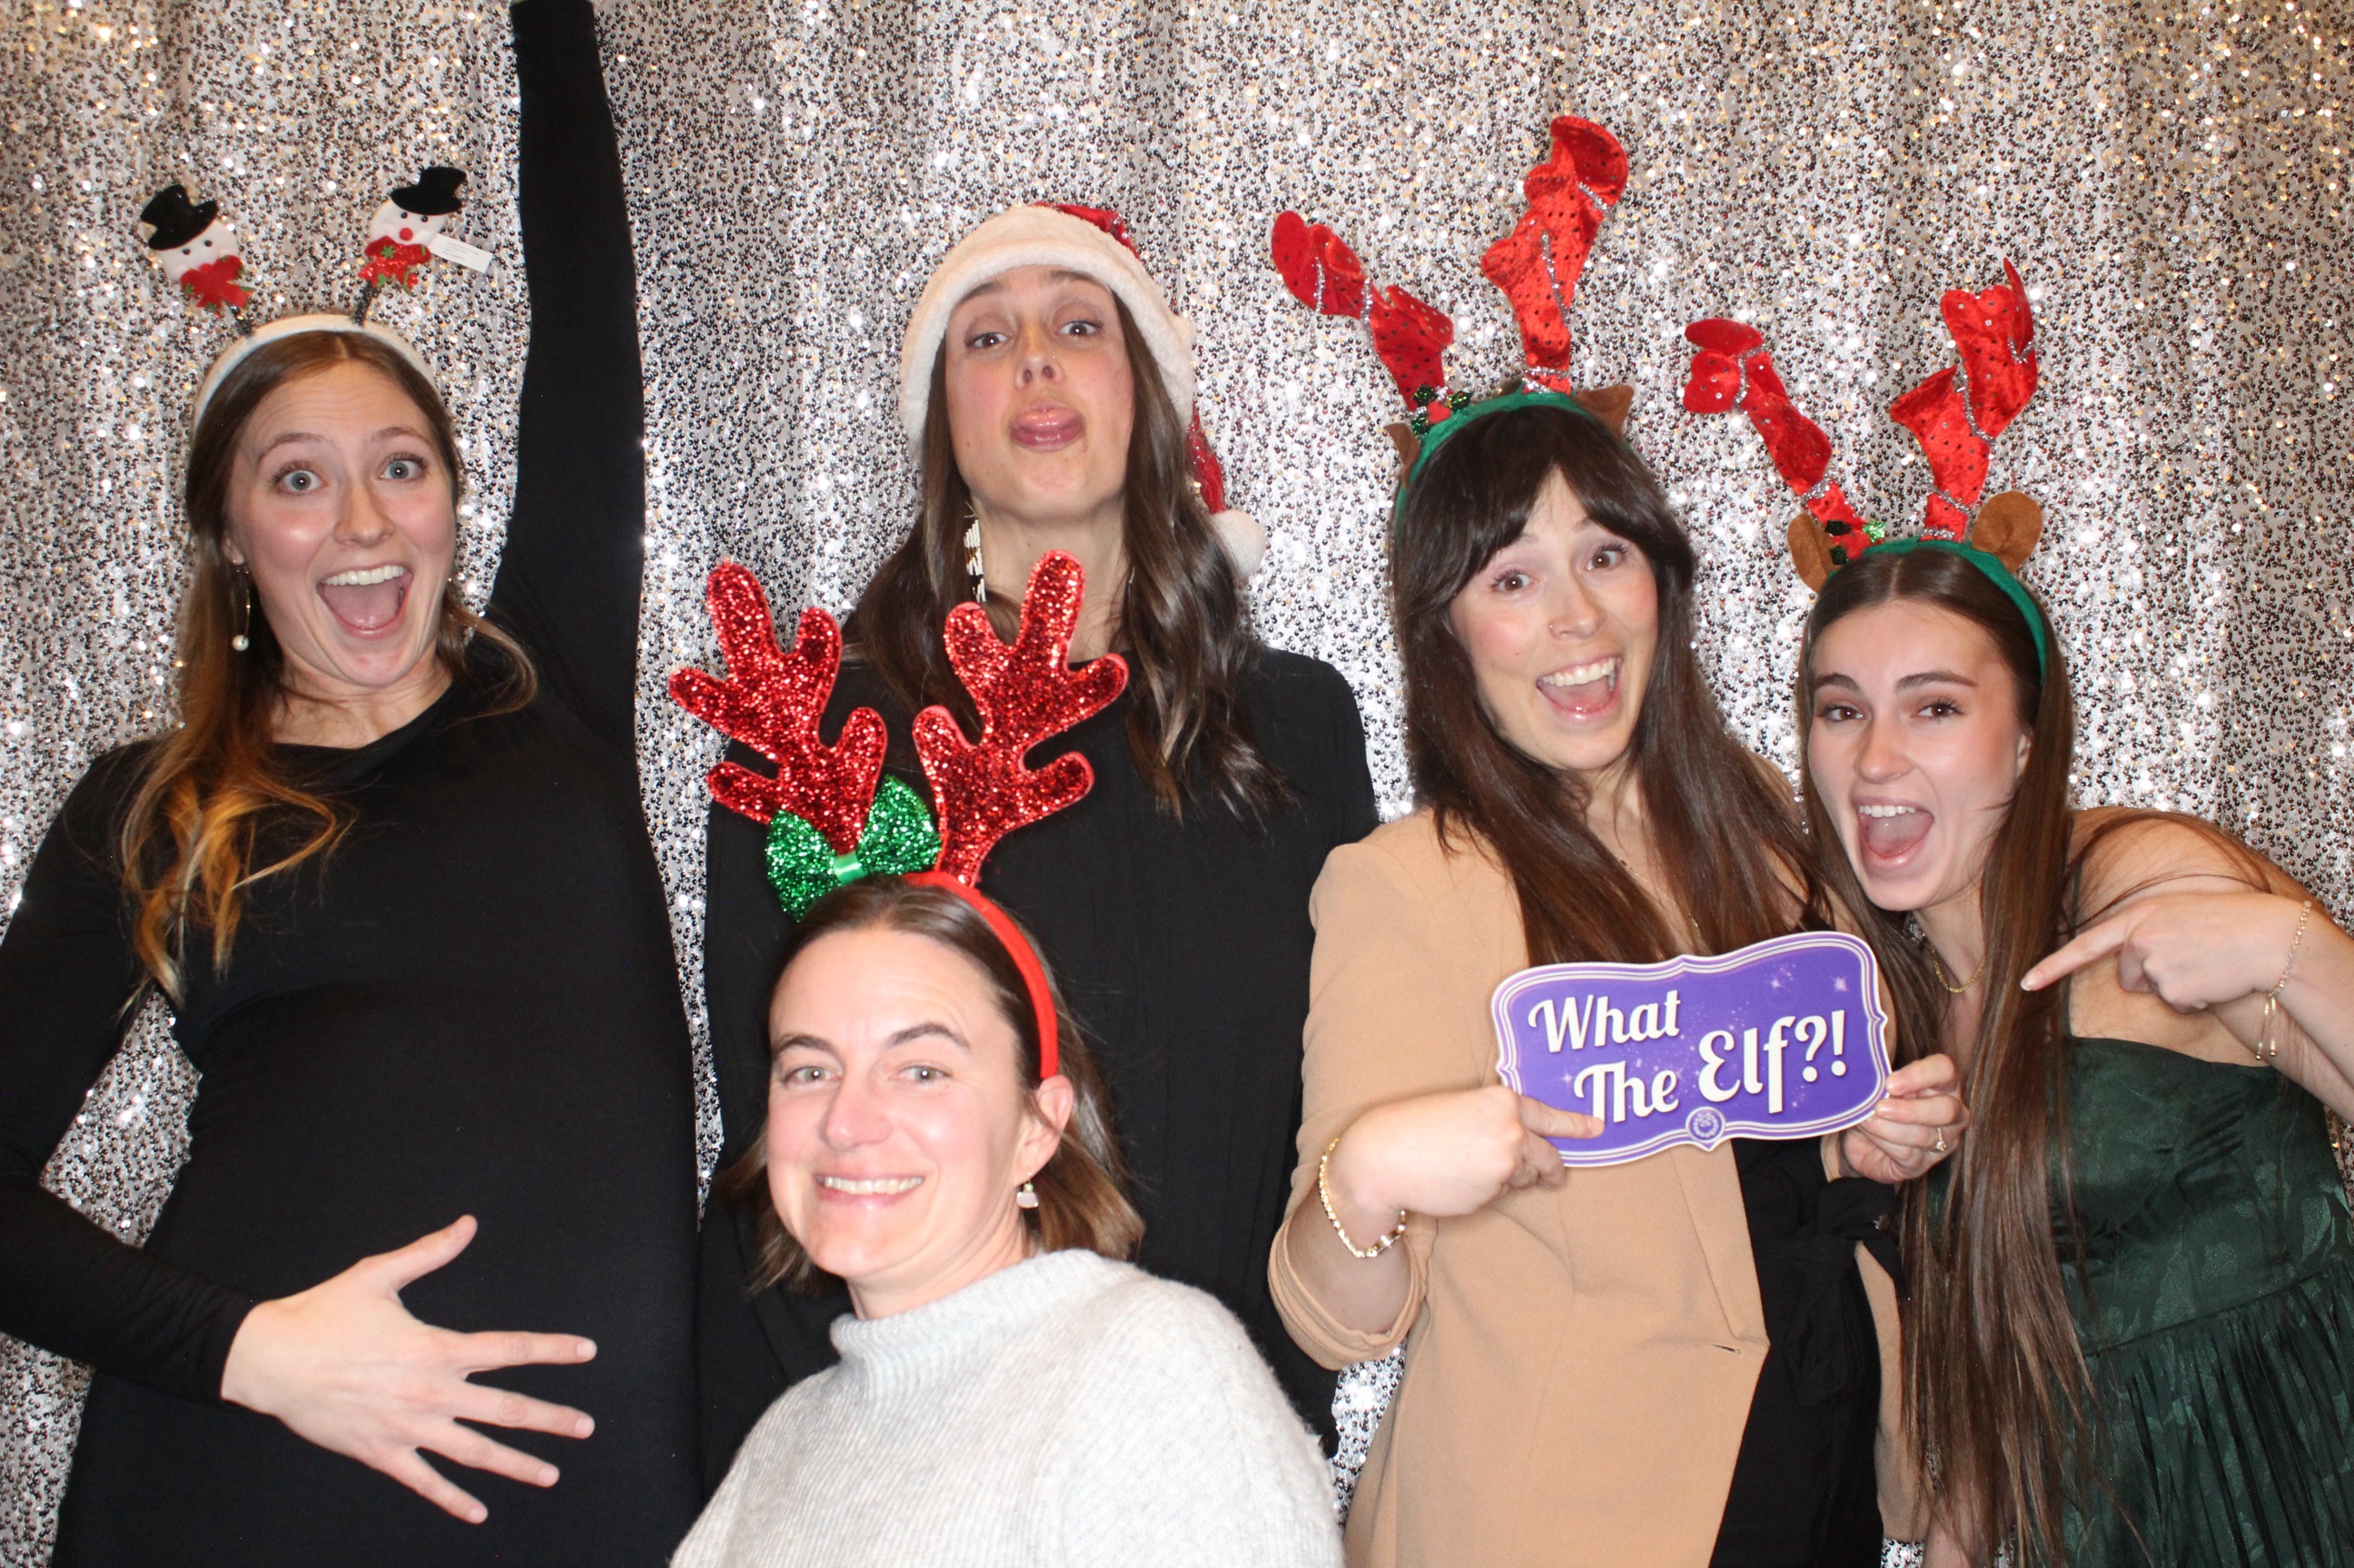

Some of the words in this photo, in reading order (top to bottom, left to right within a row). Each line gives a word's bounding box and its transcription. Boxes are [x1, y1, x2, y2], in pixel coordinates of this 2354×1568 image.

[1528, 990, 1680, 1053] What
[1573, 1060, 1678, 1123] The
[1697, 1009, 1846, 1114] Elf?!
